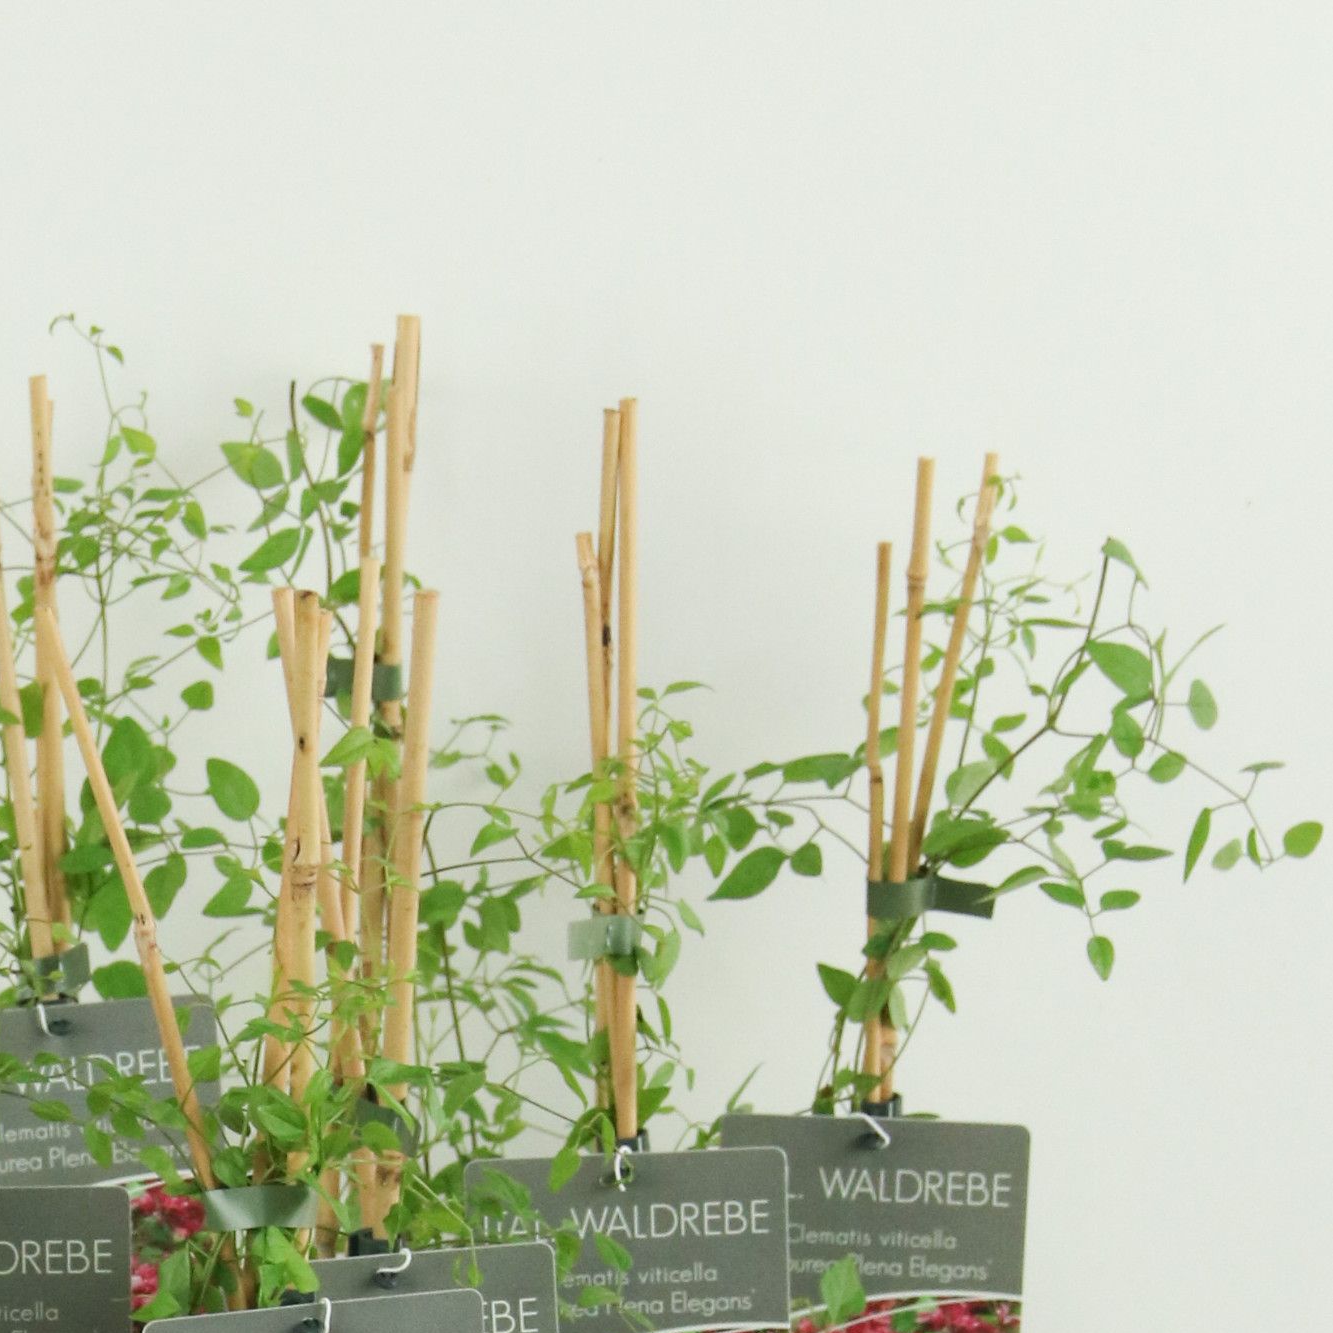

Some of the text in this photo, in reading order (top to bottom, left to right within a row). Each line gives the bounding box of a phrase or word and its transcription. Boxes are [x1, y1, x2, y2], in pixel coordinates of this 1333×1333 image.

[49, 1146, 98, 1168] Plen
[819, 1166, 1012, 1208] WALDREBE
[571, 1199, 770, 1240] WALDREBE
[880, 1230, 958, 1250] viticella
[638, 1262, 718, 1284] viticella
